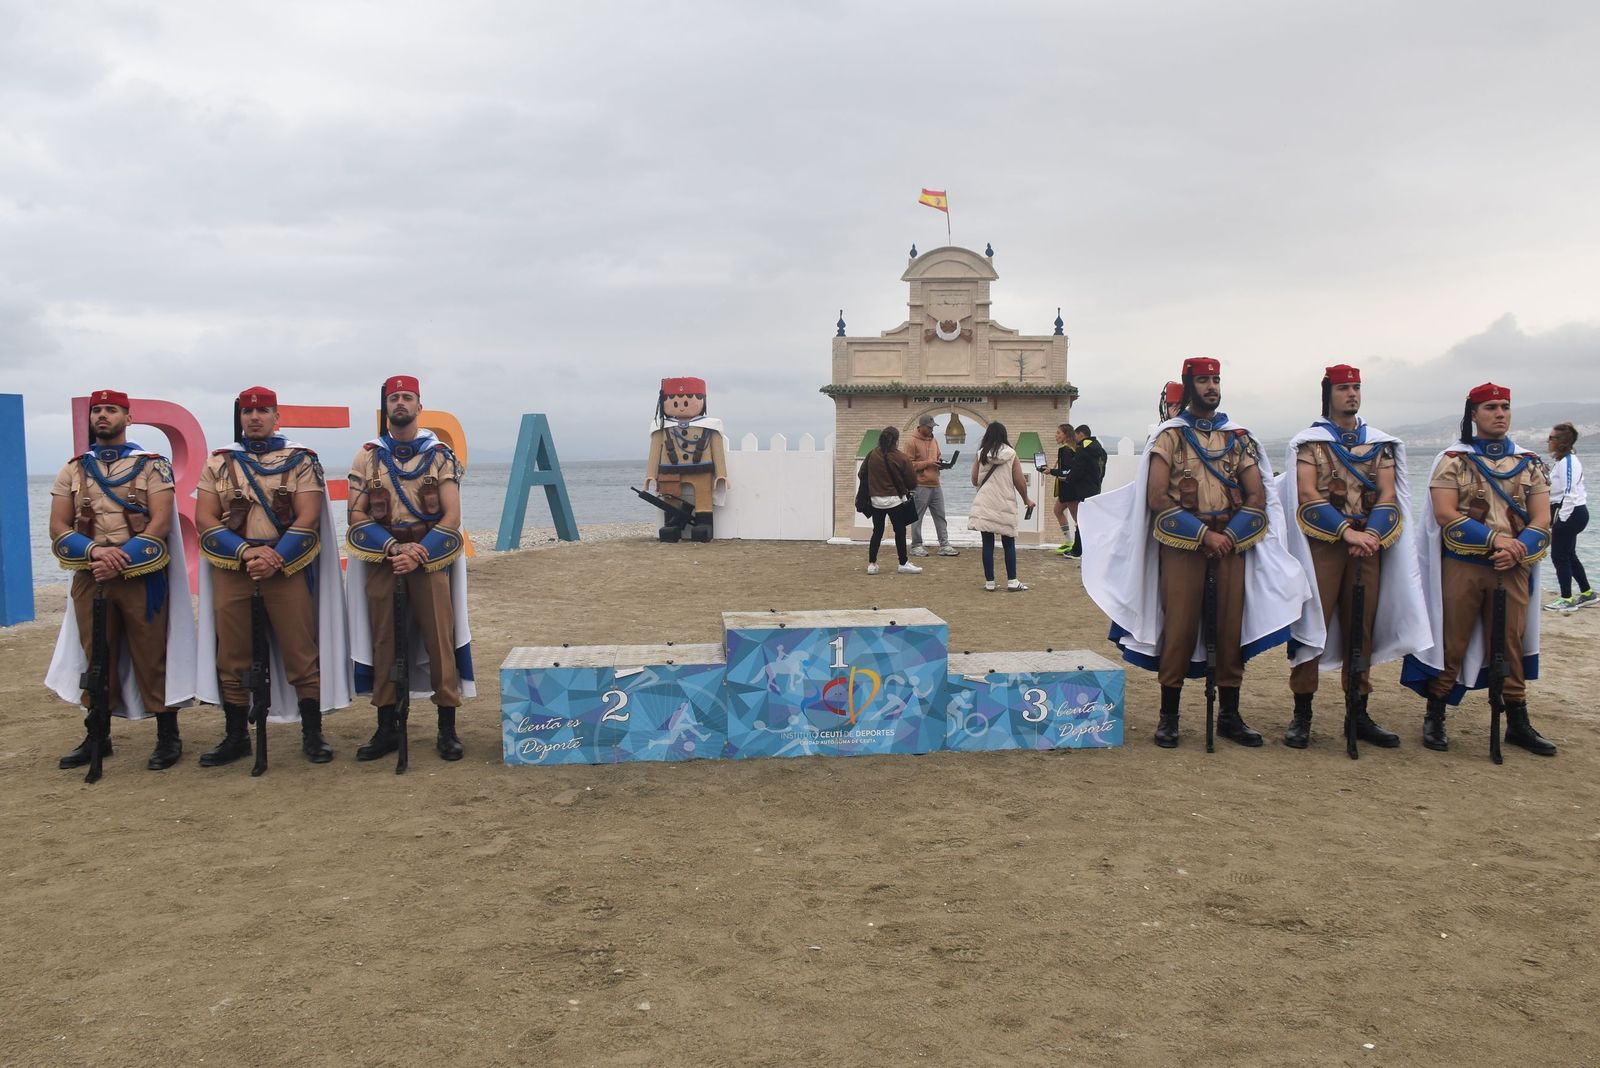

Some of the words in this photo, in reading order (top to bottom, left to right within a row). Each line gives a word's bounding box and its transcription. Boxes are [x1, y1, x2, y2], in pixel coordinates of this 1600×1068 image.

[828, 636, 849, 668] 1
[601, 689, 630, 722] 2
[1022, 688, 1049, 723] 3
[1056, 701, 1098, 717] Ceuta
[1101, 702, 1115, 712] es
[516, 716, 563, 734] Ceuta
[565, 717, 583, 729] es
[856, 729, 896, 737] DEPORTES
[1058, 719, 1116, 742] Deporte
[521, 736, 583, 760] Deporte
